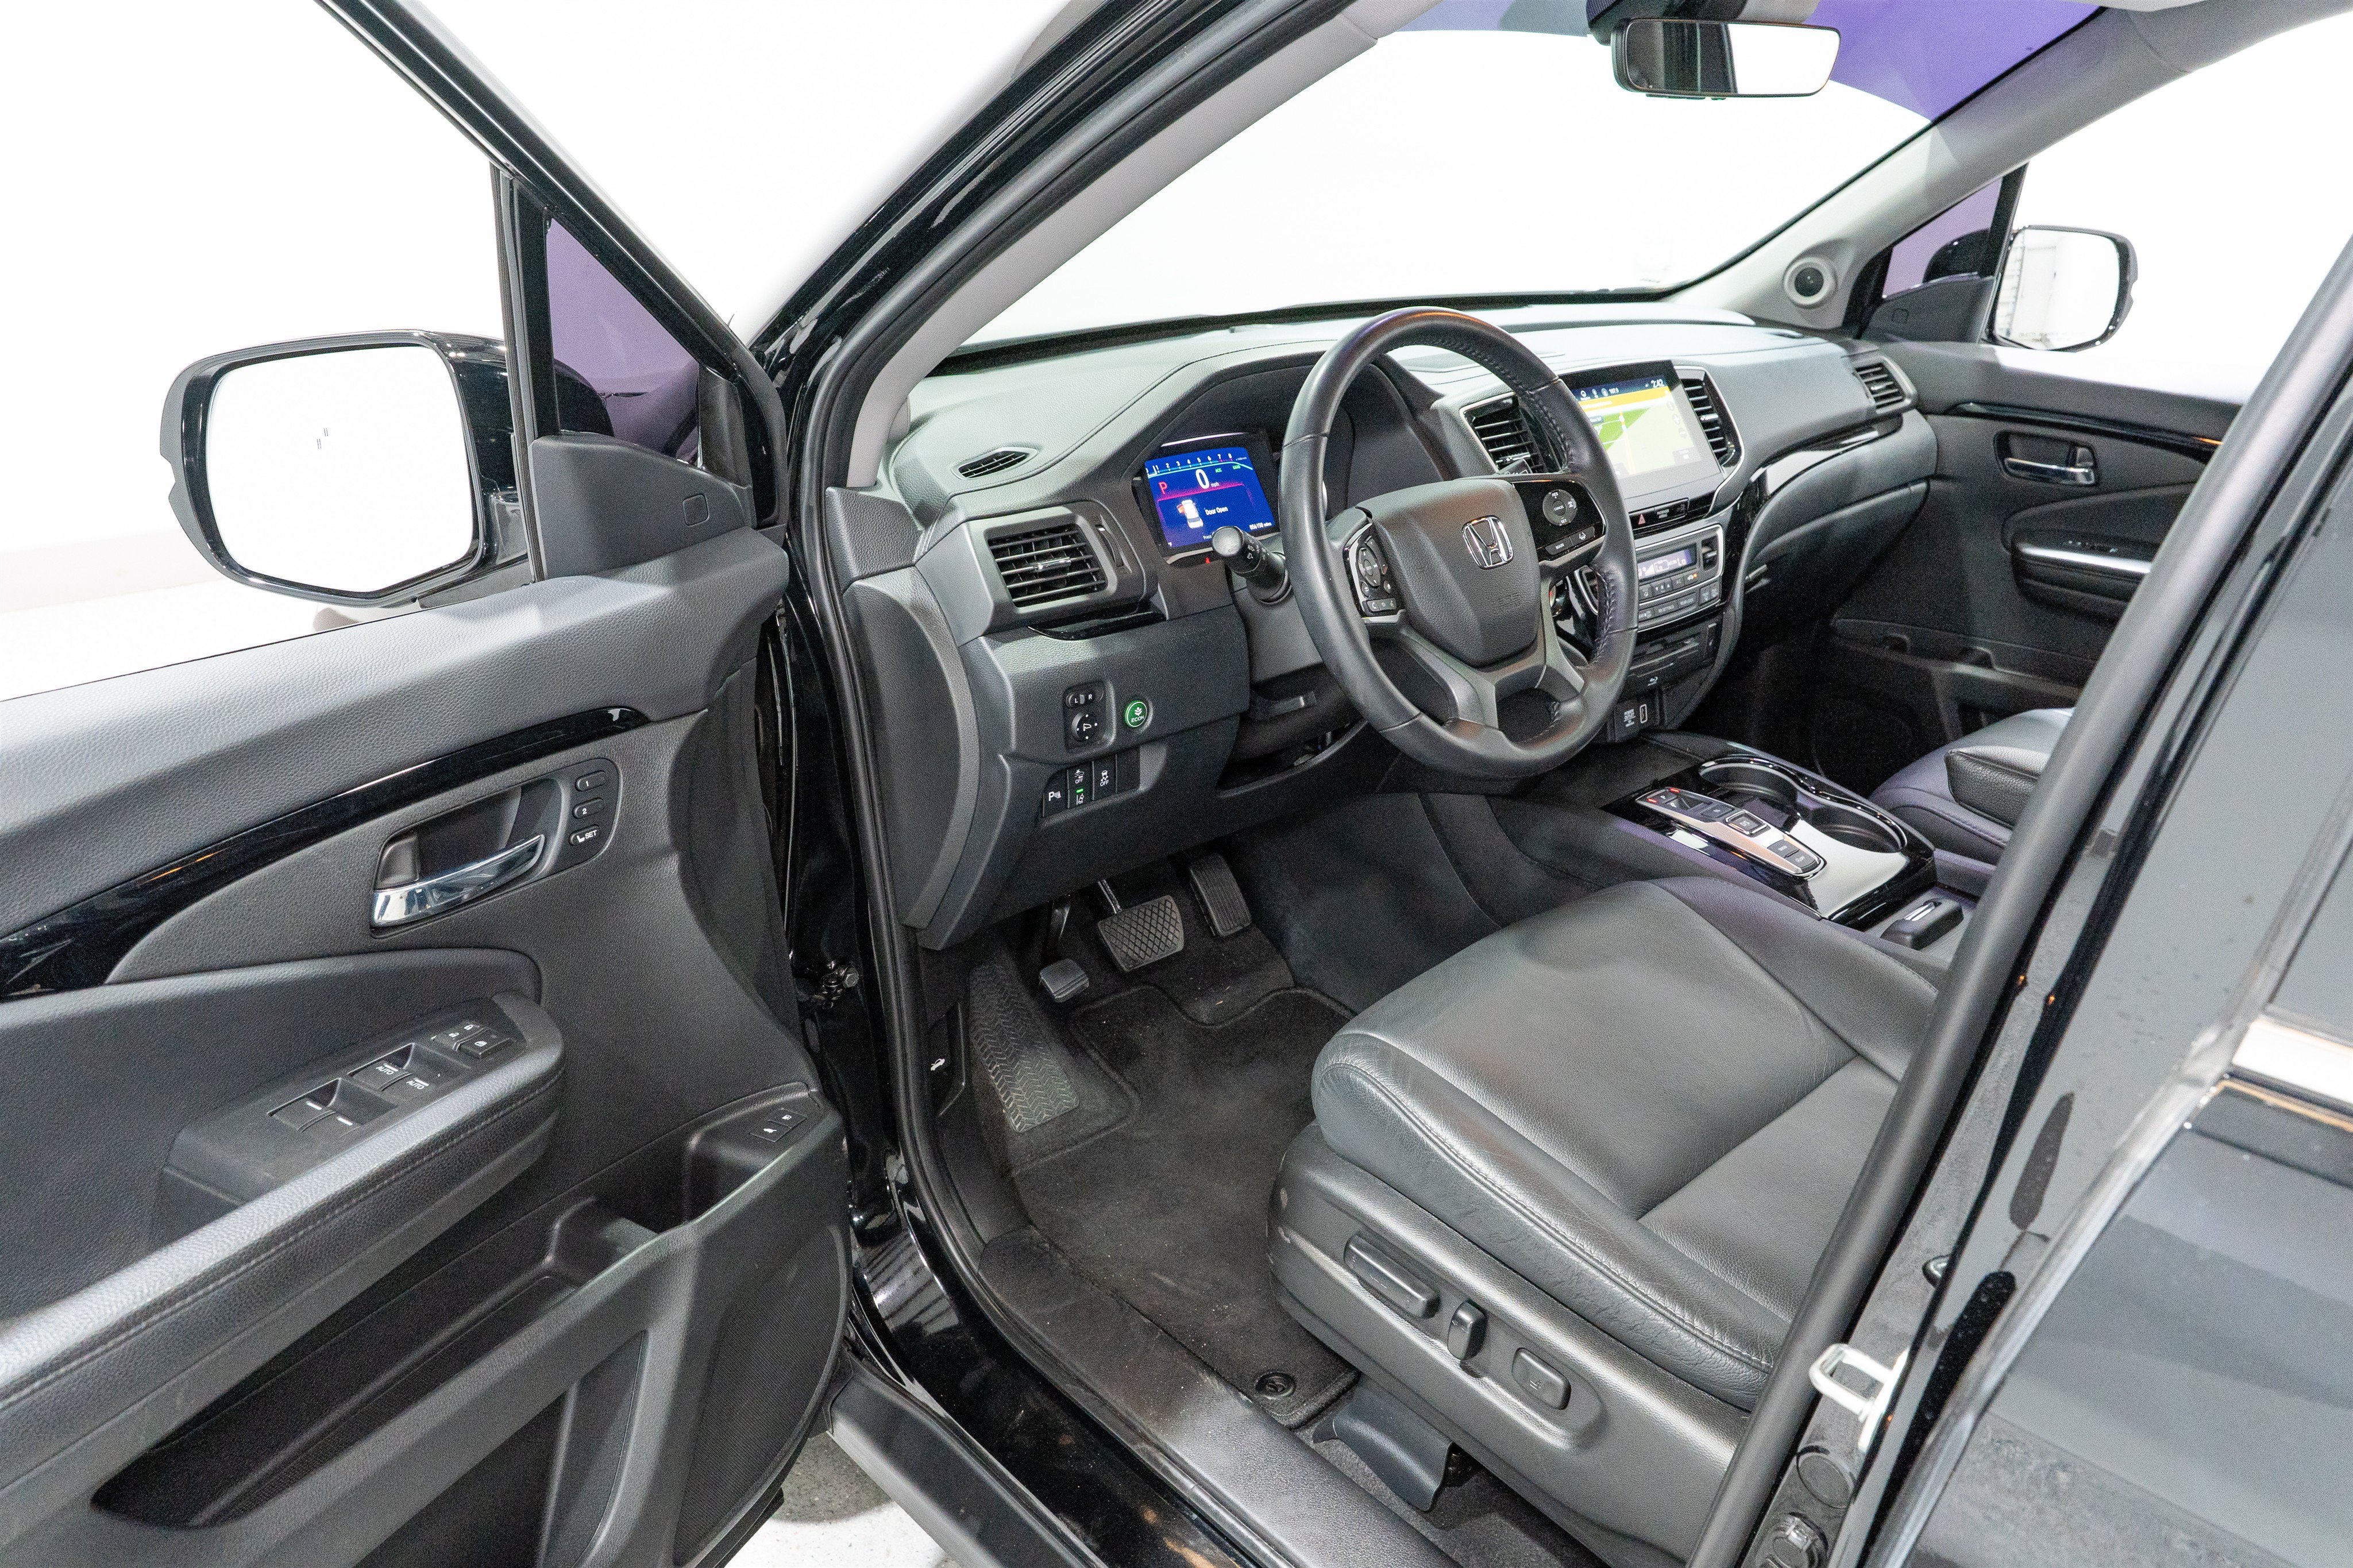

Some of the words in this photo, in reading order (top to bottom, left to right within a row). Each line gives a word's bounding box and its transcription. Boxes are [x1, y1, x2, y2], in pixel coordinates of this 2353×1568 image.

[1195, 469, 1210, 489] 0
[1158, 481, 1168, 495] P
[1131, 715, 1145, 723] ECON
[585, 829, 597, 839] SET
[376, 1065, 395, 1075] AUTO
[406, 1079, 425, 1090] AUTO
